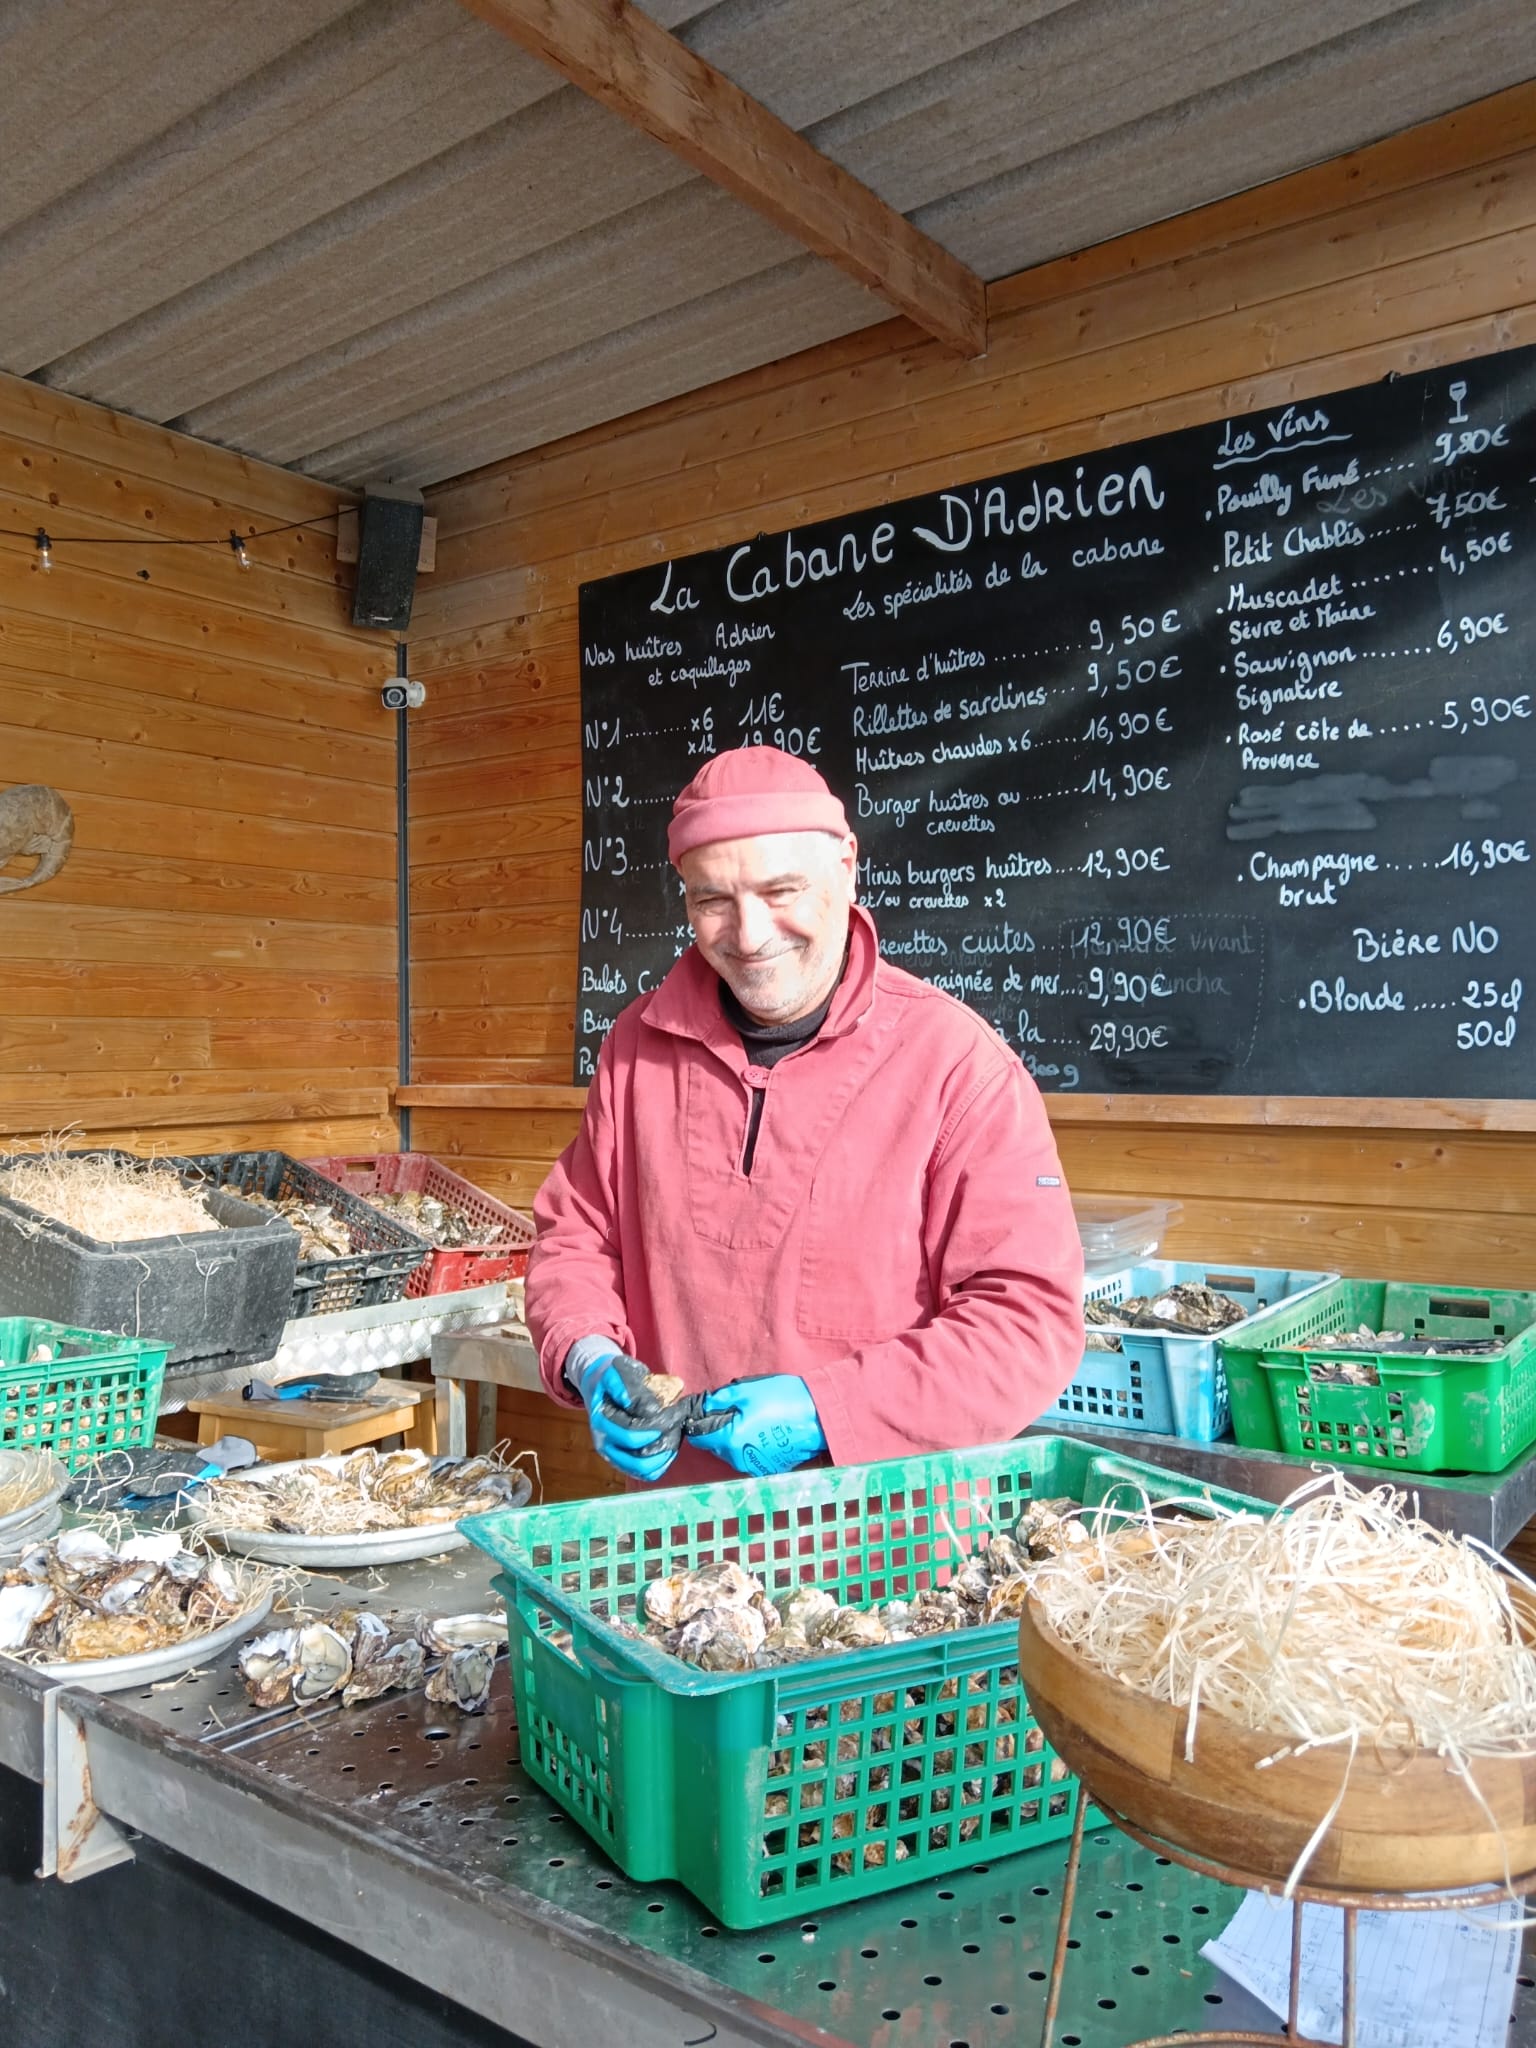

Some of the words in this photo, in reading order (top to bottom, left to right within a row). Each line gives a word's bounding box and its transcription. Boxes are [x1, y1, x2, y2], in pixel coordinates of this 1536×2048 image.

[1217, 420, 1255, 456] Les
[1268, 406, 1330, 442] Vins
[1217, 473, 1292, 516] Pouilly
[649, 560, 700, 614] La
[726, 521, 895, 602] Cabane
[912, 464, 1165, 552] D'Adrien
[1224, 530, 1274, 569] Petit
[1283, 520, 1365, 557] Chablis
[843, 590, 876, 621] Les
[883, 569, 973, 619] spécialités
[985, 562, 1010, 589] de
[1021, 553, 1048, 579] la
[1072, 537, 1165, 568] cabane
[1228, 574, 1344, 611] Muscadet
[1289, 610, 1311, 632] et
[1316, 601, 1376, 629] Maine
[585, 643, 615, 667] Nos
[625, 636, 682, 661] huîtres
[715, 622, 775, 649] Adrien
[648, 670, 663, 686] et
[670, 655, 751, 689] coquillages
[841, 662, 909, 695] Terrine
[916, 648, 986, 682] d'huîtres
[1234, 646, 1357, 684] Sauvignon
[691, 706, 714, 731] x6
[738, 692, 785, 727] 11€
[853, 703, 928, 737] Rillettes
[933, 700, 952, 723] de
[959, 682, 1046, 720] sardines
[1236, 679, 1343, 715] Signature
[1238, 720, 1286, 746] Rosé
[1348, 717, 1374, 740] de
[856, 743, 926, 775] Huîtres
[932, 733, 1003, 764] chaudes
[1242, 746, 1320, 771] Provence
[854, 783, 921, 829] Burger
[929, 788, 988, 812] huîtres
[998, 791, 1020, 805] ou
[927, 814, 996, 836] crevettes
[908, 860, 975, 896] burgers
[986, 852, 1052, 879] huîtres
[1250, 851, 1379, 886] Champagne
[909, 893, 970, 909] crevettes
[1279, 881, 1338, 907] brut
[879, 929, 948, 956] revettes
[962, 921, 1036, 955] cuites
[1353, 928, 1441, 964] Bière
[582, 963, 628, 994] Bulots
[1003, 964, 1024, 992] de
[1030, 973, 1060, 996] mer
[1310, 976, 1405, 1014] Blonde
[1019, 1008, 1046, 1043] la
